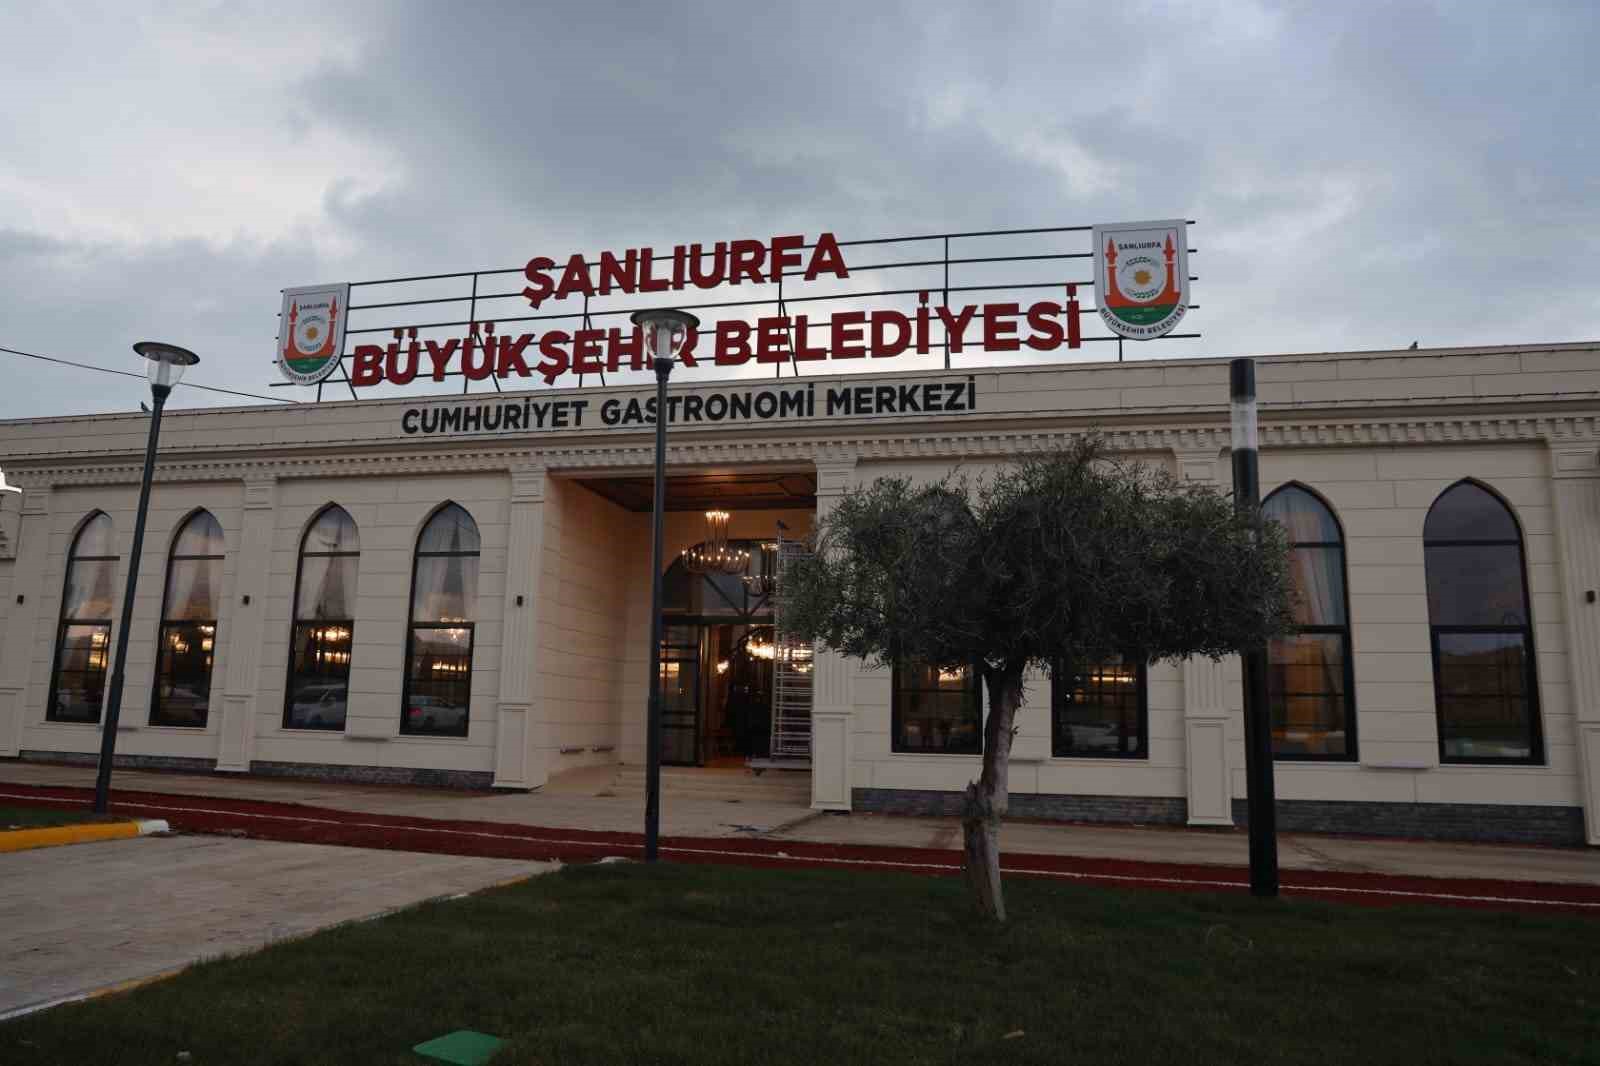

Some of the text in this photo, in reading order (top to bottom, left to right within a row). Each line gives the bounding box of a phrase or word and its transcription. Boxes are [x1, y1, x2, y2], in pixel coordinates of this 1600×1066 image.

[523, 233, 849, 309] ŞANLIURFA
[714, 283, 1081, 366] BELEDİYESİ
[401, 375, 976, 435] CUMHURİYET GASTRONOMİ MERKEZİ
